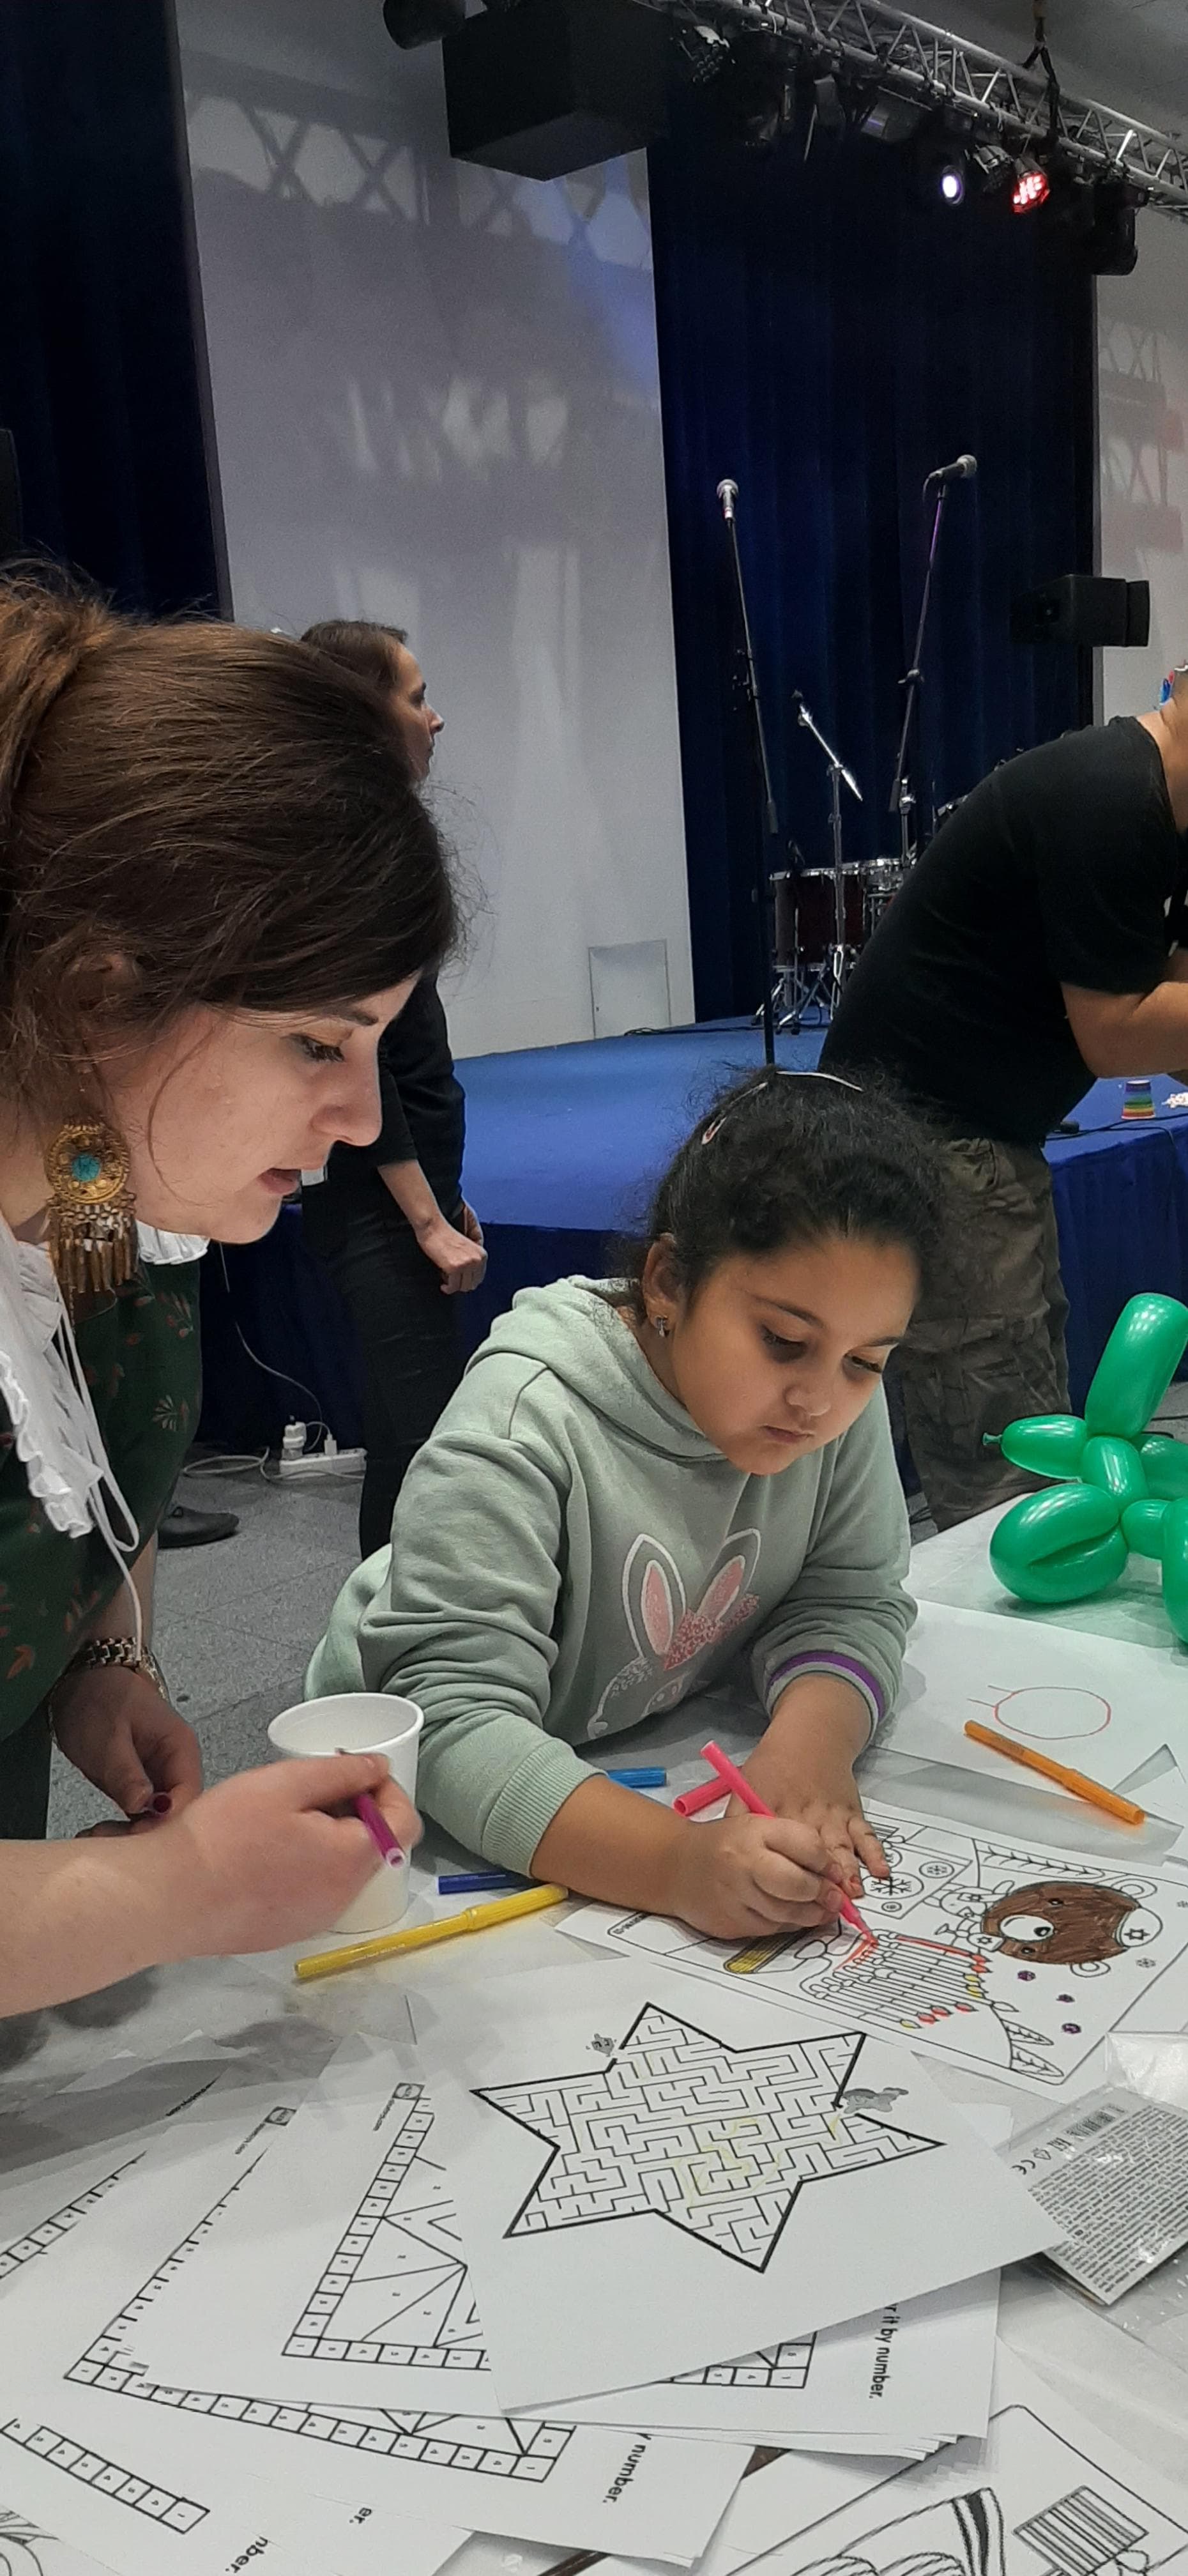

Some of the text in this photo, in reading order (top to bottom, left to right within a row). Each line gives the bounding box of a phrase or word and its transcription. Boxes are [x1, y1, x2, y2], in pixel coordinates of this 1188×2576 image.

[875, 2328, 898, 2343] by
[881, 2316, 901, 2324] it
[869, 2347, 890, 2399] number.
[602, 2444, 646, 2503] number.
